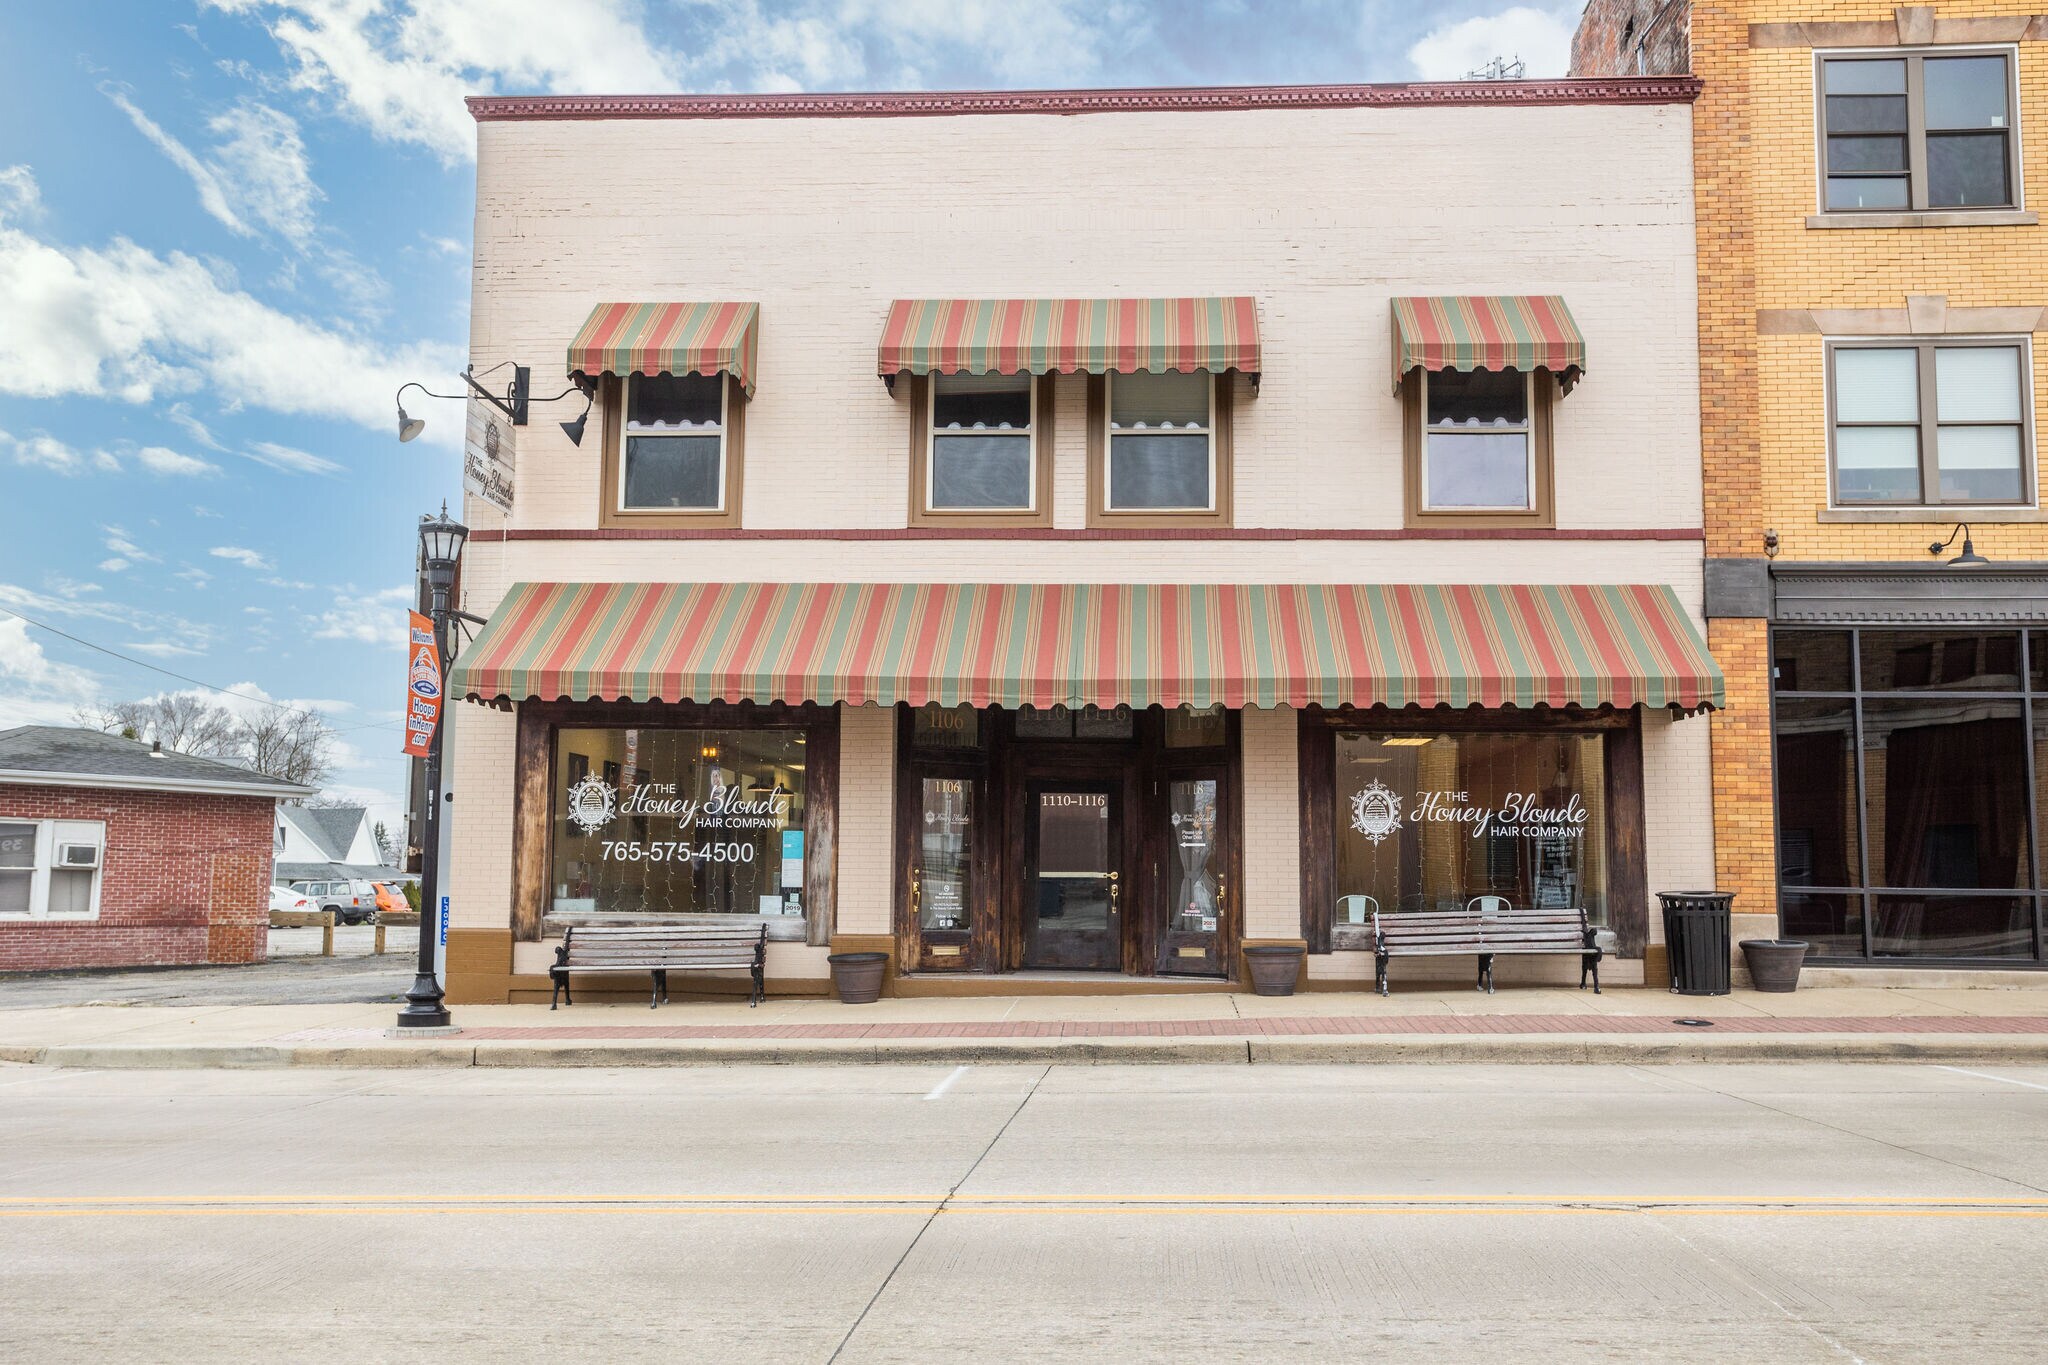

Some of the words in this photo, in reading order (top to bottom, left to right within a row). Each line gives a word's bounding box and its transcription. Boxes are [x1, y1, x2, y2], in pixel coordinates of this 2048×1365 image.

[465, 451, 489, 496] Honey
[490, 468, 514, 502] Blonde
[414, 698, 435, 717] Hoops
[409, 716, 434, 735] inHenry
[930, 710, 964, 729] 1106
[412, 734, 427, 745] .com
[653, 784, 676, 794] THE
[935, 781, 961, 793] 1106
[1180, 784, 1204, 795] 1118
[1444, 791, 1468, 802] THE
[620, 784, 700, 829] Honey
[703, 785, 789, 815] Blonde
[1410, 791, 1495, 838] Honey
[1498, 792, 1589, 823] Blonde
[695, 818, 723, 828] HAIR
[725, 818, 784, 829] COMPANY
[1491, 826, 1519, 837] HAIR
[1522, 826, 1584, 838] COMPANY
[601, 841, 754, 863] 765-575-4500
